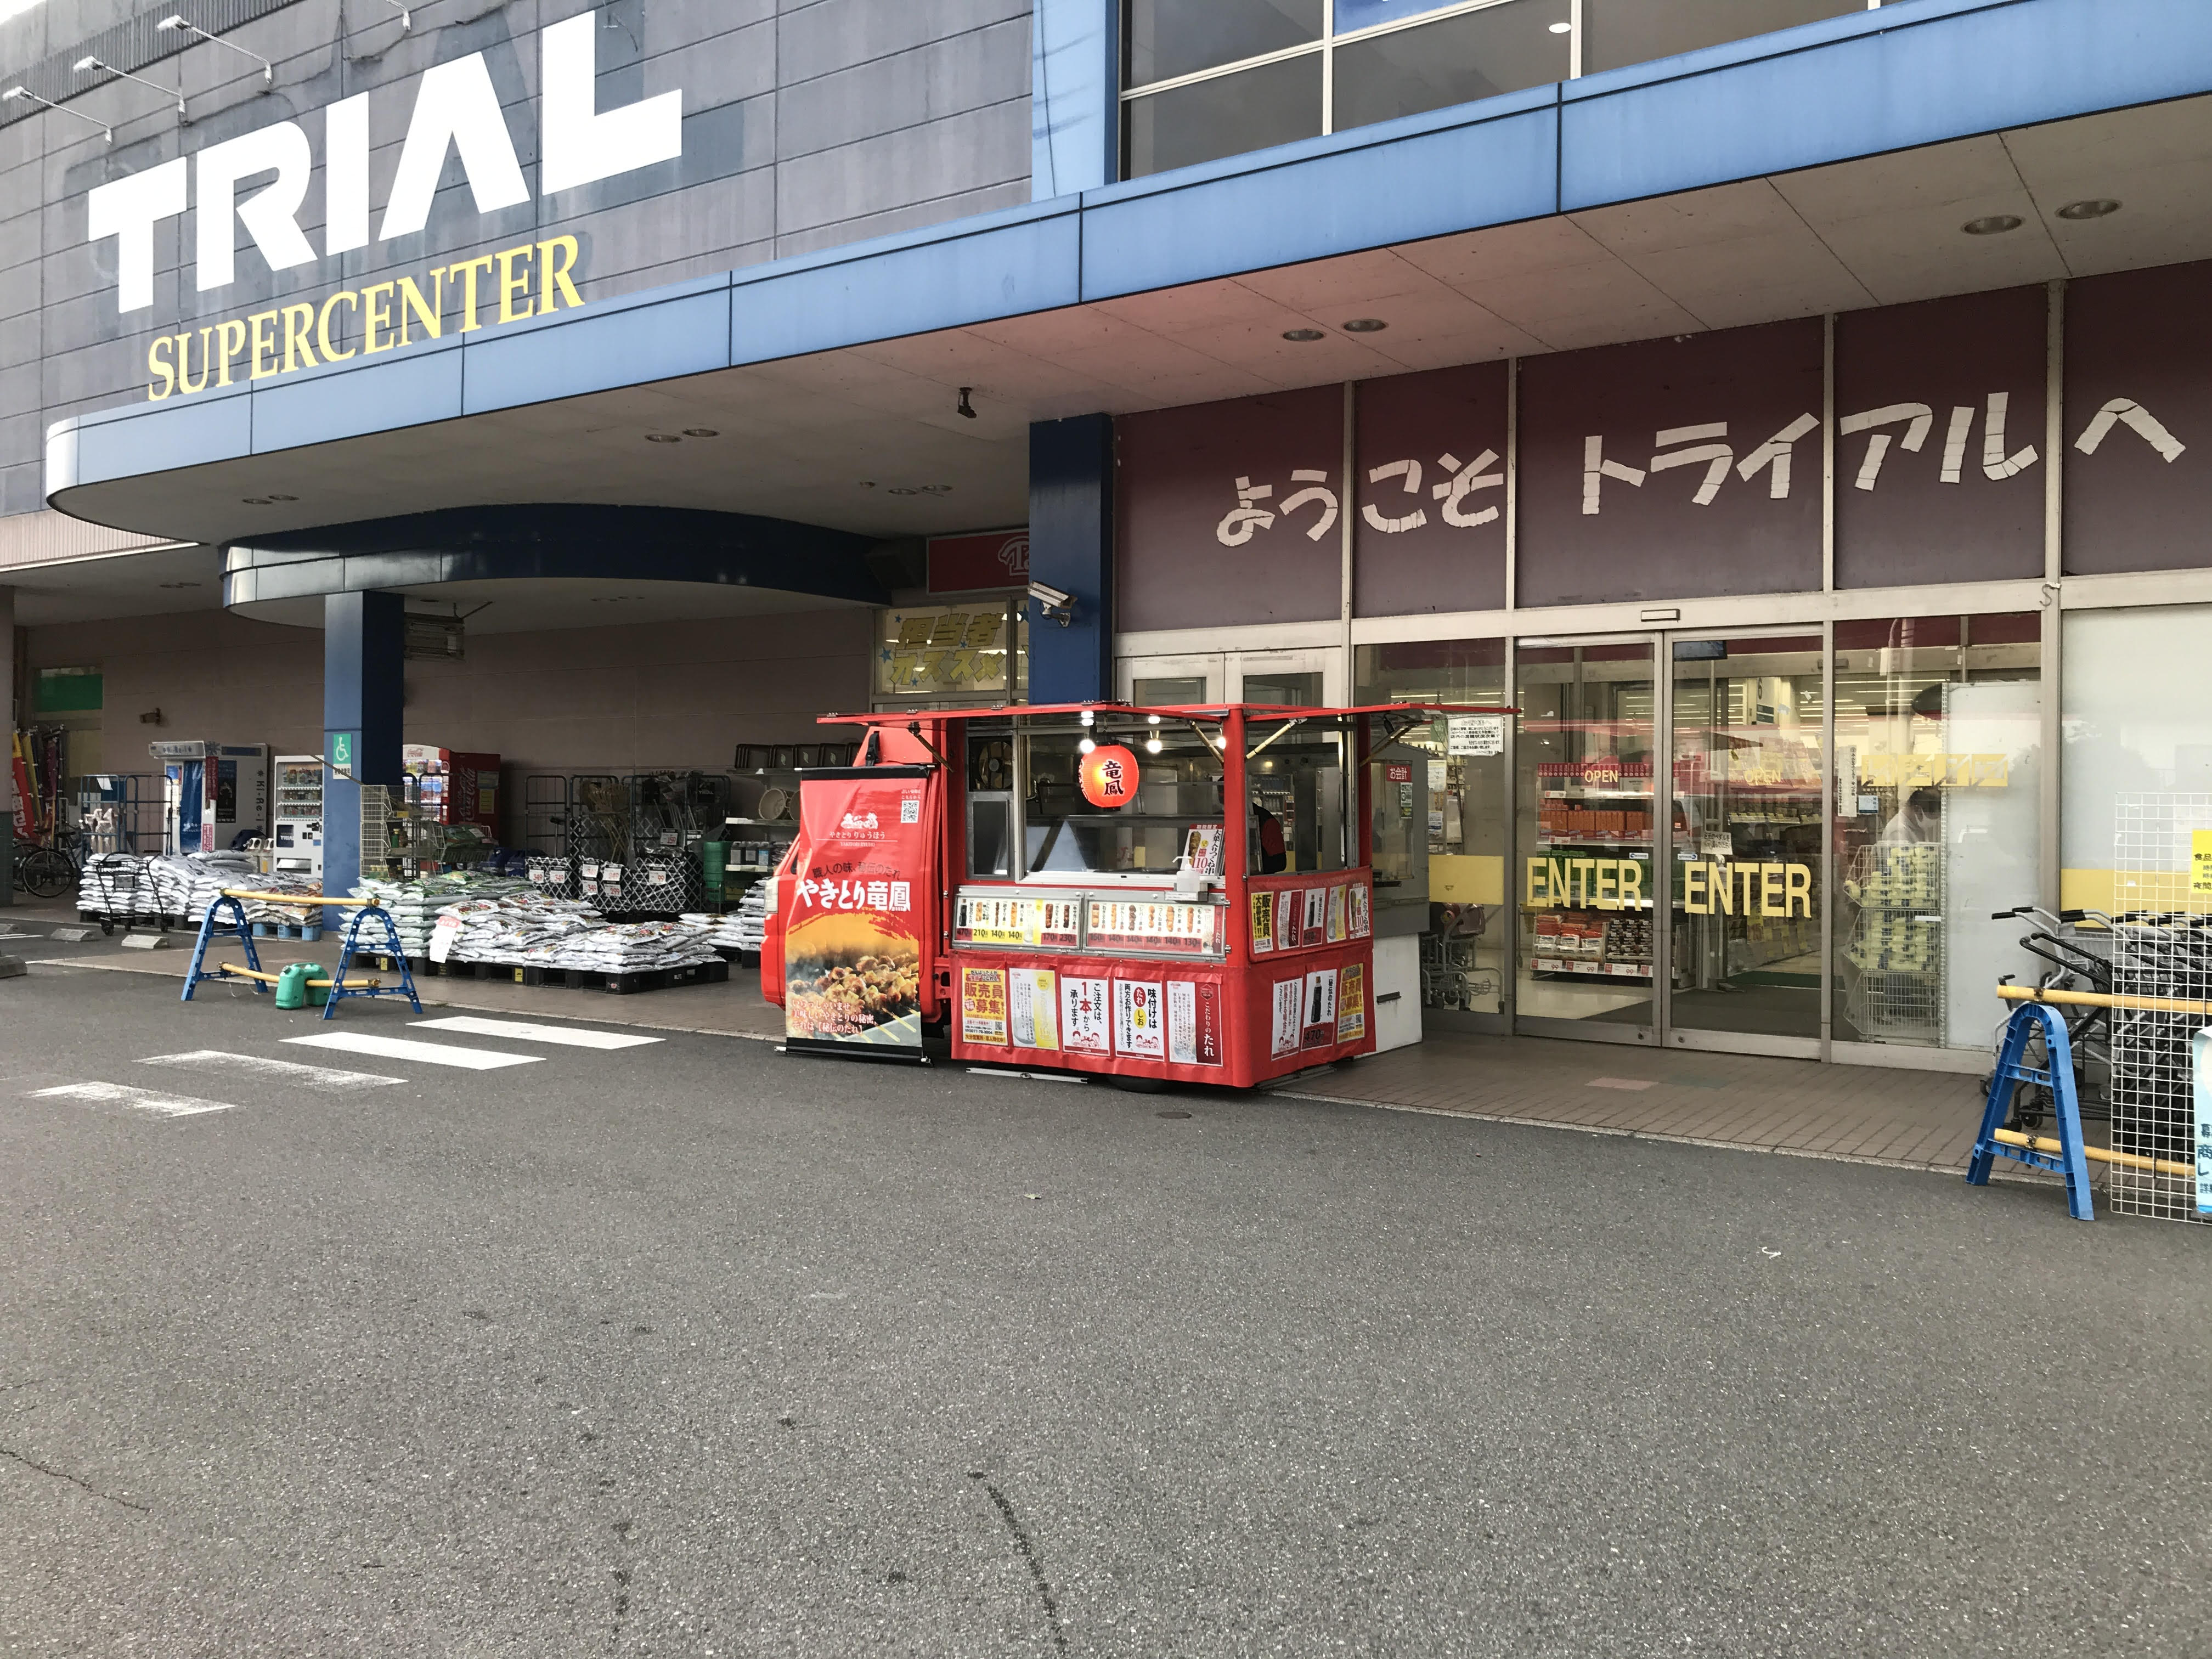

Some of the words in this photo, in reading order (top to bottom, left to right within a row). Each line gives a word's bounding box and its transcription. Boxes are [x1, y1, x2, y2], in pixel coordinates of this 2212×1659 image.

[88, 9, 682, 314] TRIAL
[148, 234, 585, 401] SUPERCENTER
[1216, 448, 1504, 547] ようこそ
[1581, 391, 2186, 516] トライアルへ
[895, 612, 1004, 650] 担当者
[890, 649, 1006, 685] オススメ
[1584, 770, 1618, 783] OPEN
[1745, 770, 1781, 783] OPEN
[797, 878, 911, 912] やきとり竜鳳
[1527, 857, 1642, 911] ENTER
[1684, 862, 1812, 918] ENTER
[1262, 894, 1271, 937] 販売員
[792, 999, 851, 1011] いらっしゃいませ
[965, 982, 1004, 999] 販売員
[1070, 989, 1079, 1030] 承ります。
[1080, 981, 1092, 1031] 1本から
[1093, 983, 1102, 1024] ご注文は、
[1136, 989, 1143, 1005] たれ
[1147, 989, 1157, 1029] 味付けは
[1125, 984, 1133, 1051] 両方お作りできます。
[1137, 1011, 1144, 1026] しお
[1204, 1002, 1214, 1057] こだわりのたれ
